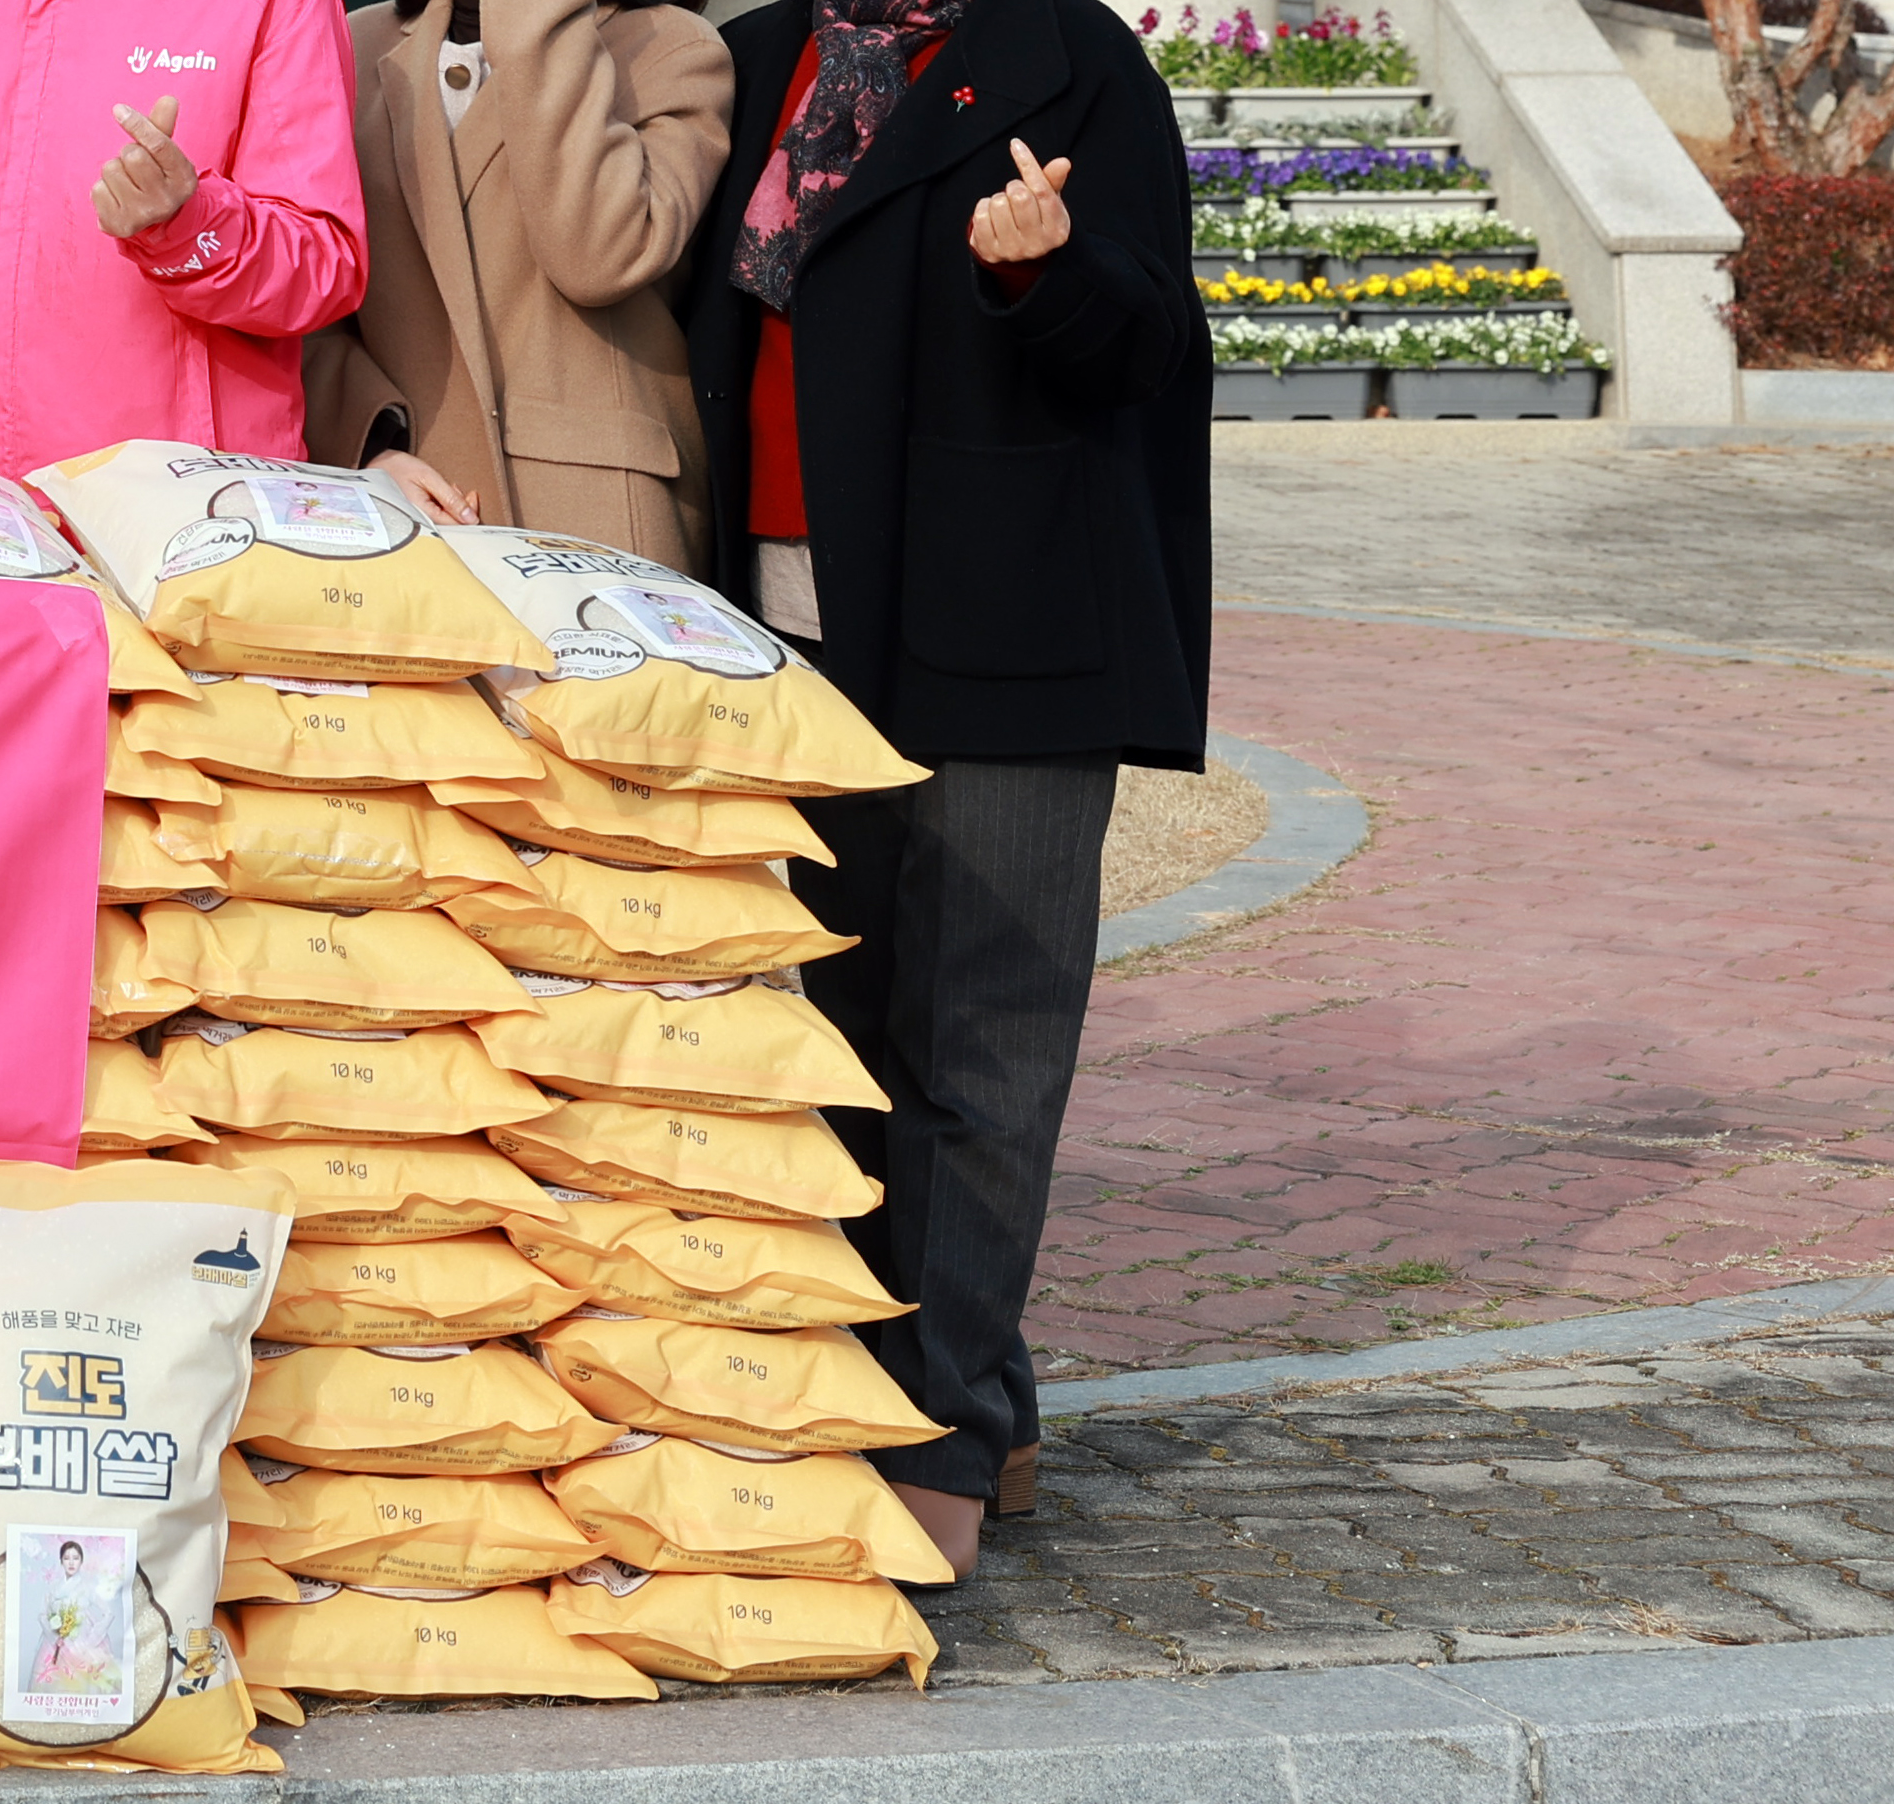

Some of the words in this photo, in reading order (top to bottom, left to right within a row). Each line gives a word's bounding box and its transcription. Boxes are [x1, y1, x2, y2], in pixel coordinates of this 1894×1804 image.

[154, 49, 216, 73] Again
[321, 587, 340, 604] 10
[343, 588, 363, 608] kg
[553, 647, 641, 660] REMIUM
[302, 714, 320, 730] 10
[324, 714, 346, 733] kg
[707, 703, 727, 721] 10
[730, 707, 749, 729] kg
[607, 776, 628, 793] 10
[630, 775, 652, 800] kg
[323, 796, 343, 811] 10
[345, 798, 368, 816] kg
[620, 898, 640, 914] 10
[644, 899, 662, 919] kg
[307, 937, 327, 953] 10
[330, 938, 348, 960] kg
[659, 1024, 676, 1041] 10
[679, 1027, 700, 1046] kg
[330, 1062, 350, 1078] 10
[354, 1063, 373, 1084] kg
[667, 1120, 683, 1138] 10
[687, 1125, 708, 1146] kg
[325, 1160, 344, 1176] 10
[347, 1160, 368, 1180] kg
[680, 1234, 699, 1250] 10
[704, 1238, 724, 1259] kg
[351, 1265, 371, 1280] 10
[375, 1265, 396, 1284] kg
[3, 1311, 57, 1329] 해풍을
[65, 1311, 98, 1332] 맞고
[106, 1318, 141, 1340] 자란
[726, 1355, 745, 1372] 10
[748, 1359, 768, 1381] kg
[19, 1348, 127, 1419] 진도
[390, 1387, 410, 1403] 10
[414, 1388, 434, 1408] kg
[94, 1430, 177, 1500] 쌀
[731, 1487, 750, 1504] 10
[754, 1490, 774, 1511] kg
[378, 1504, 398, 1520] 10
[402, 1505, 422, 1525] kg
[727, 1604, 747, 1619] 10
[752, 1605, 772, 1625] kg
[414, 1627, 432, 1643] 10
[436, 1627, 457, 1646] kg
[22, 1695, 55, 1706] 사랑을
[57, 1697, 100, 1707] 전합니다
